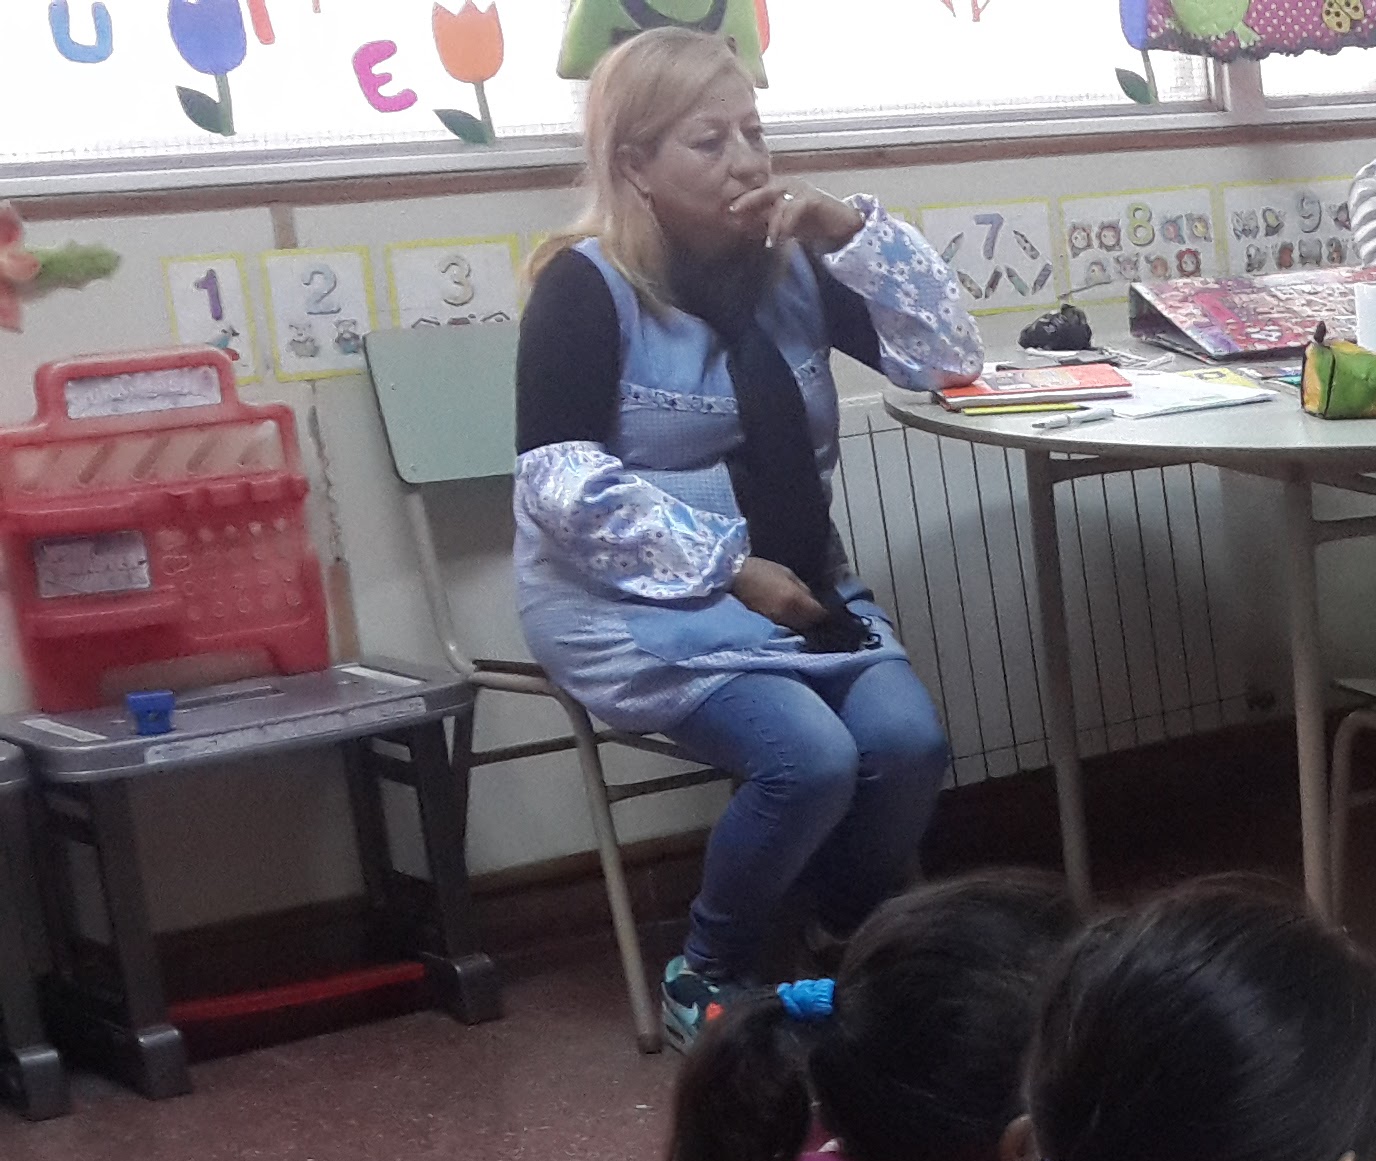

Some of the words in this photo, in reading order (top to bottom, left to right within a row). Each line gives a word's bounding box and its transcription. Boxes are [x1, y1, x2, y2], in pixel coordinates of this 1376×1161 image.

[353, 40, 418, 113] E
[974, 212, 1005, 261] 7
[1127, 203, 1156, 248] 8
[1296, 191, 1322, 234] 9
[194, 268, 224, 321] 1
[301, 263, 342, 316] 2
[438, 254, 475, 307] 3
